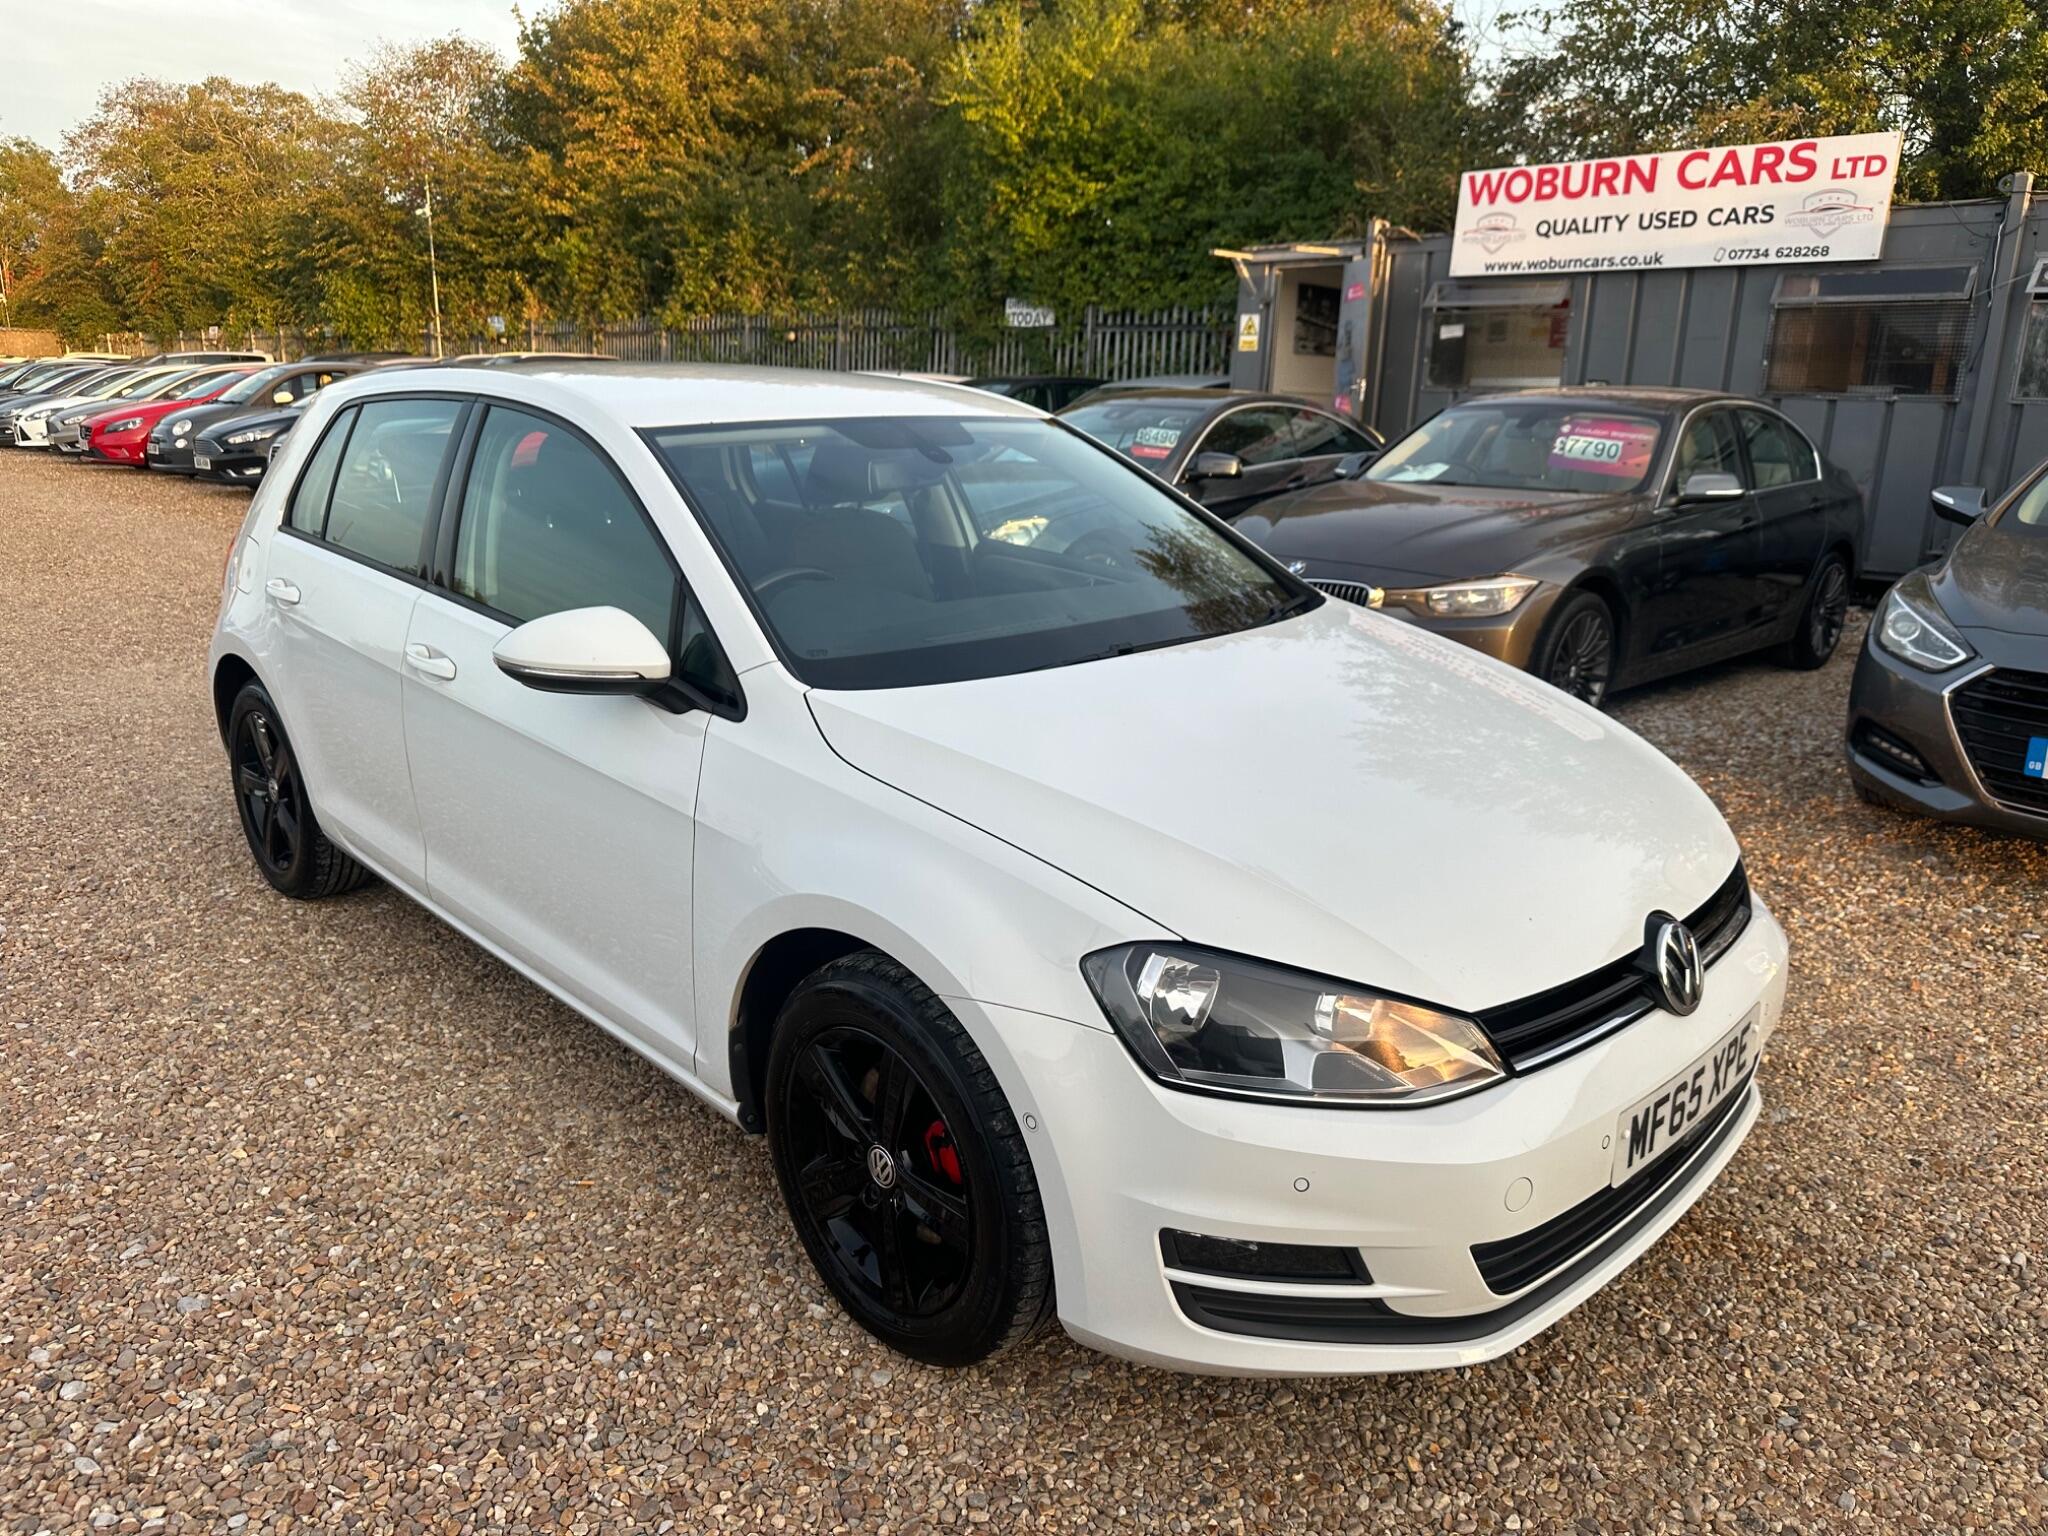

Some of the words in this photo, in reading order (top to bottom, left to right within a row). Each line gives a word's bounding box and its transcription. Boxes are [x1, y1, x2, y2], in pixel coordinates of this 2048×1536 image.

[1468, 157, 1659, 207] WOBURN
[1677, 142, 1818, 191] CARS
[1831, 154, 1888, 180] LTD
[1536, 214, 1630, 239] QUALITY
[1638, 209, 1698, 231] USED
[1707, 204, 1775, 227] CARS
[1484, 251, 1664, 272] www.woburncars.co.uk
[1728, 249, 1770, 260] 07734
[1775, 245, 1830, 259] 628268
[1627, 1064, 1705, 1168] MF65
[1707, 1021, 1752, 1105] XPE
